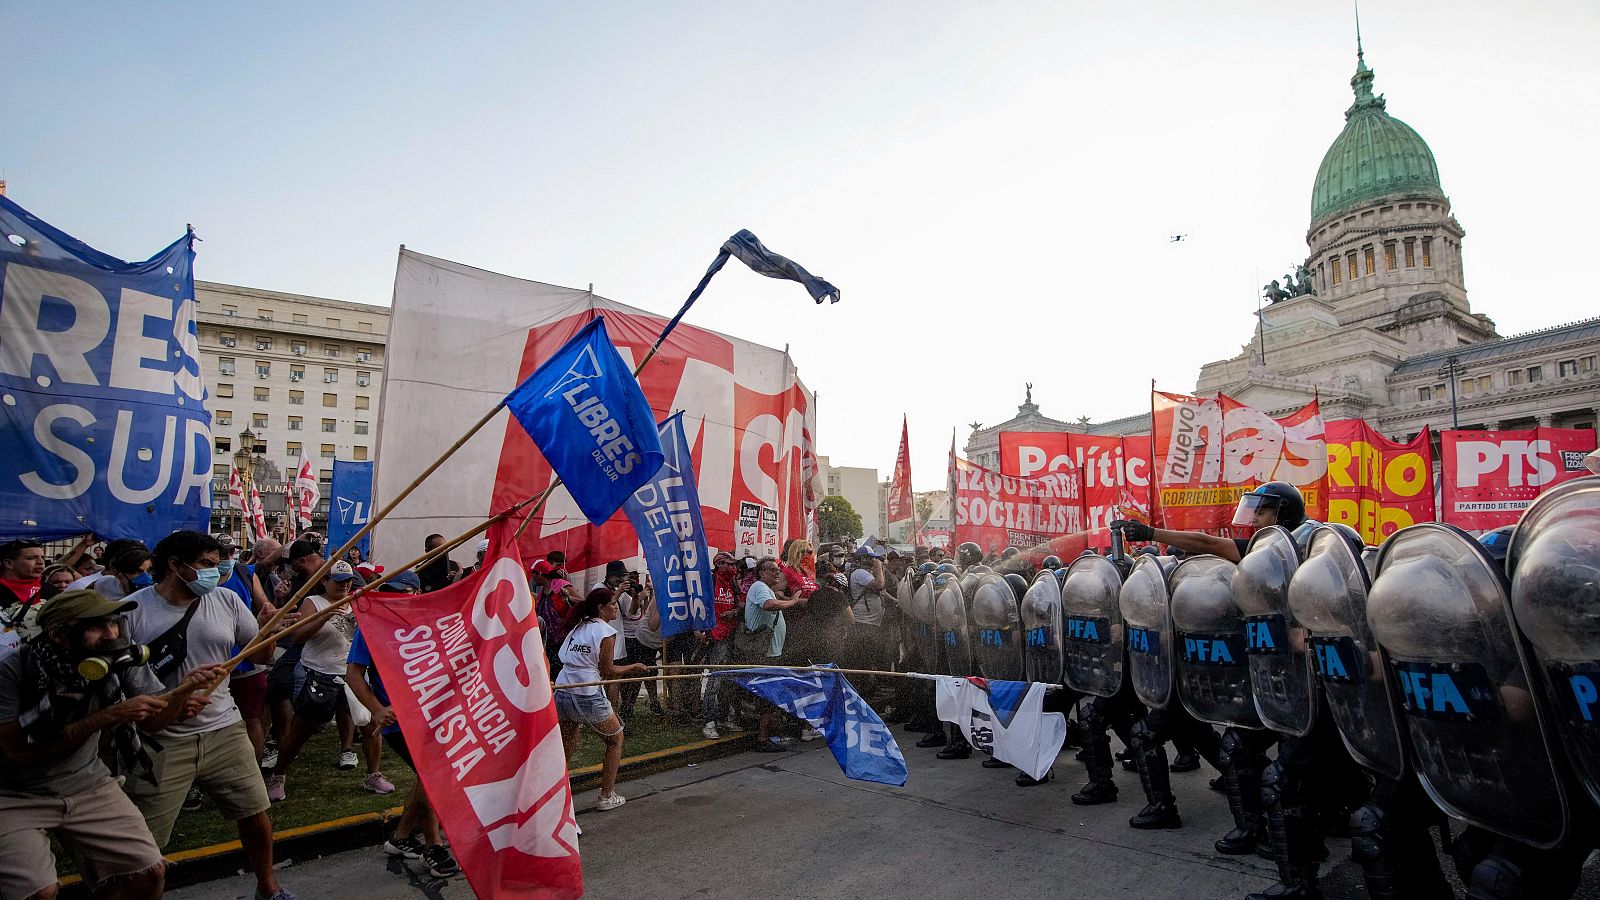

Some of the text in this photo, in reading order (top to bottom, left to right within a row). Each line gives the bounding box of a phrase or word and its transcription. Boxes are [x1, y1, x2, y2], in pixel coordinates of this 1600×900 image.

[562, 382, 641, 475] LIBRES
[1170, 406, 1195, 479] nuevo
[591, 448, 619, 482] DEL SUR
[1018, 445, 1151, 488] Polític
[1456, 439, 1556, 488] PTS
[956, 467, 1079, 500] IZQUIERDA
[1163, 489, 1218, 506] CORRIENTE
[955, 496, 1082, 534] SOCIALISTA
[1459, 502, 1496, 510] PARTIDO
[633, 484, 688, 621] DEL SUR
[658, 476, 706, 621] LIBRES
[980, 629, 1004, 647] PFA
[1027, 627, 1045, 647] PFA
[1068, 618, 1099, 641] PFA
[1129, 627, 1149, 652] PFA
[1184, 637, 1233, 663] PFA
[435, 611, 517, 754] CONVERGENCIA
[1400, 669, 1471, 714] PFA
[394, 624, 487, 782] SOCIALISTA
